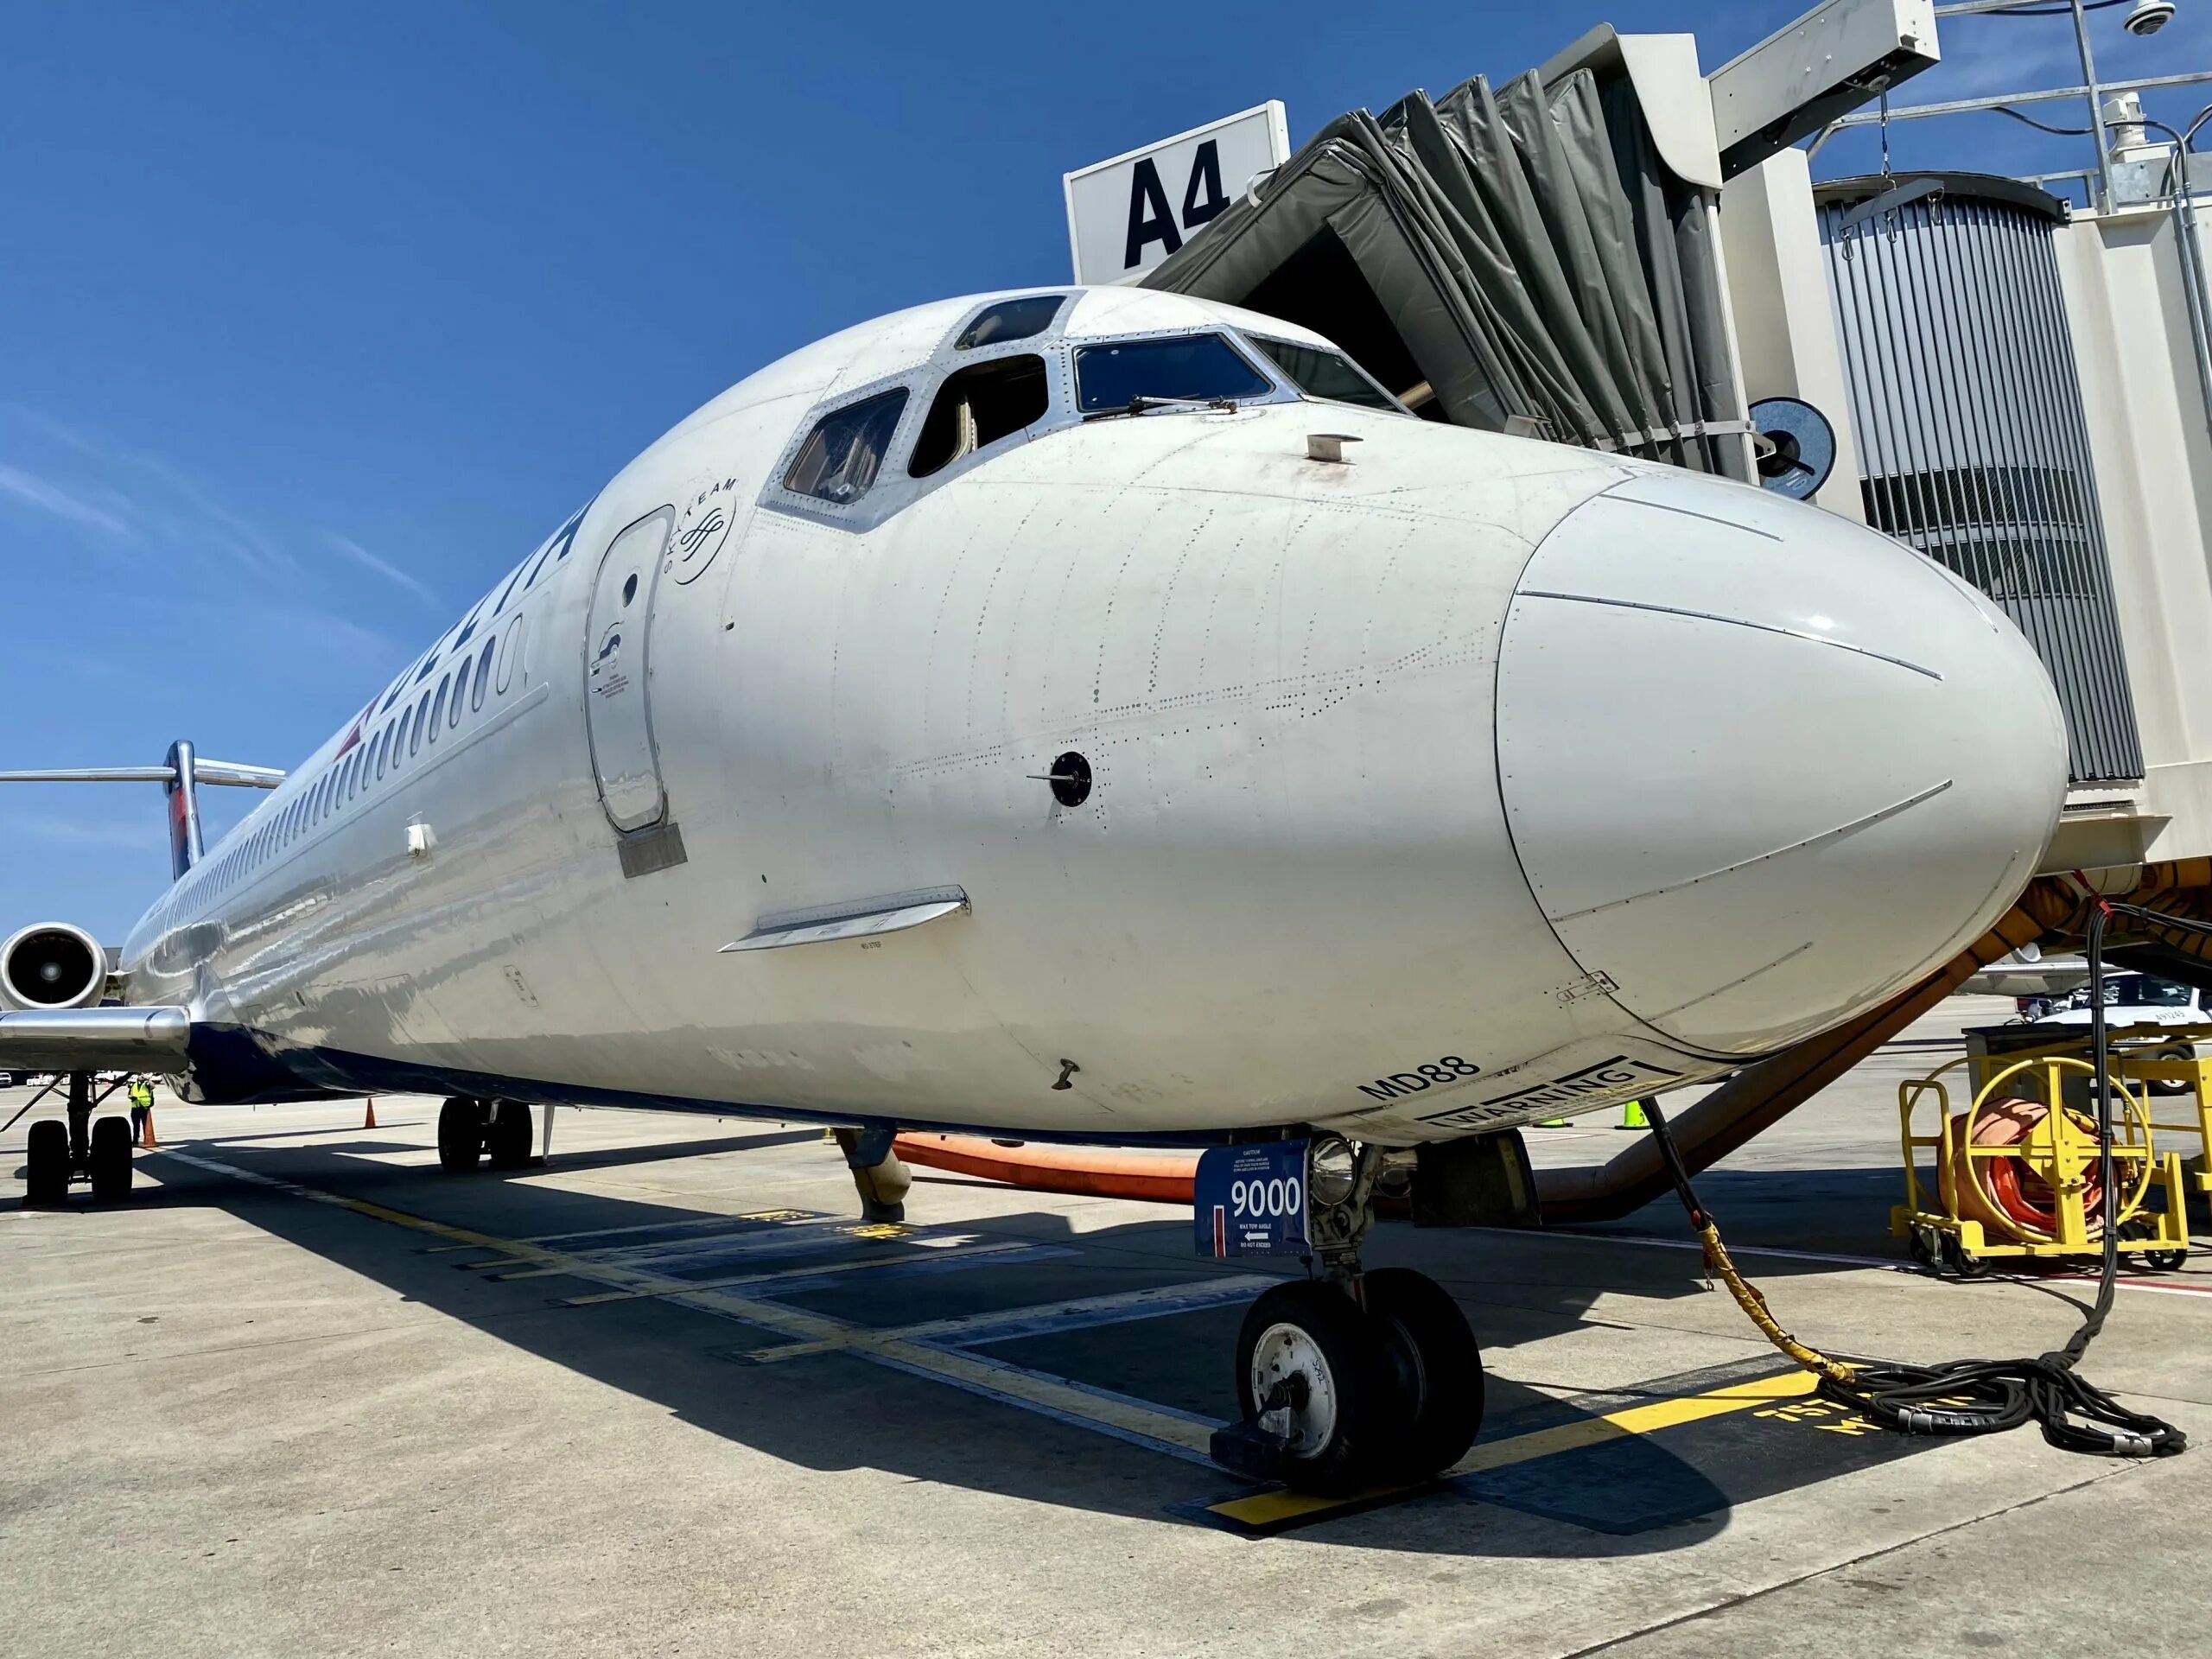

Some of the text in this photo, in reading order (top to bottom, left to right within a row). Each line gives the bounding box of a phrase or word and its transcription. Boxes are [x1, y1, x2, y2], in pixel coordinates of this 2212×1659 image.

[1124, 138, 1230, 270] A4
[1357, 1055, 1480, 1101] MD88
[1446, 1069, 1637, 1125] WARNING
[1231, 1177, 1300, 1217] 9000
